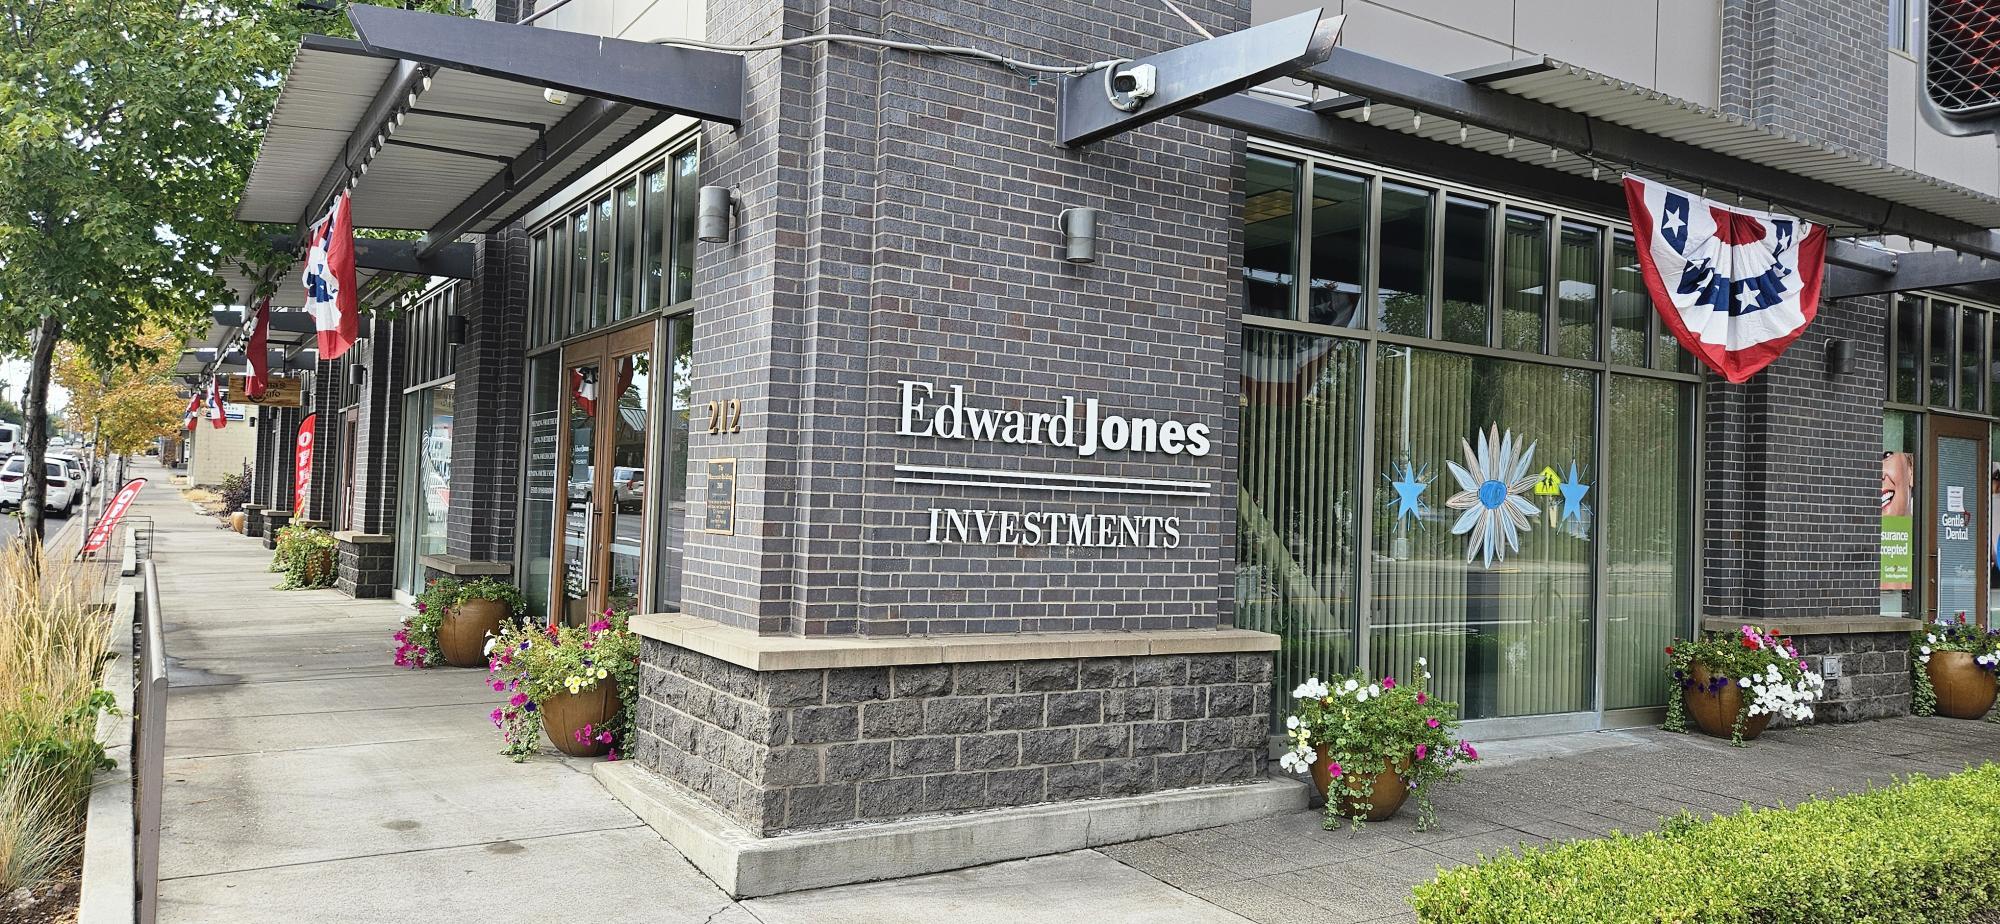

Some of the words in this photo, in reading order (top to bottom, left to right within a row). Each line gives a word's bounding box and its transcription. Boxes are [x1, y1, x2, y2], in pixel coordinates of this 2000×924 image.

[708, 399, 741, 434] 212
[1942, 513, 1965, 527] Gentle
[926, 508, 1181, 549] INVESTMENTS
[1945, 527, 1969, 540] Dental
[1881, 531, 1909, 541] surance
[1880, 543, 1908, 558] ccepted
